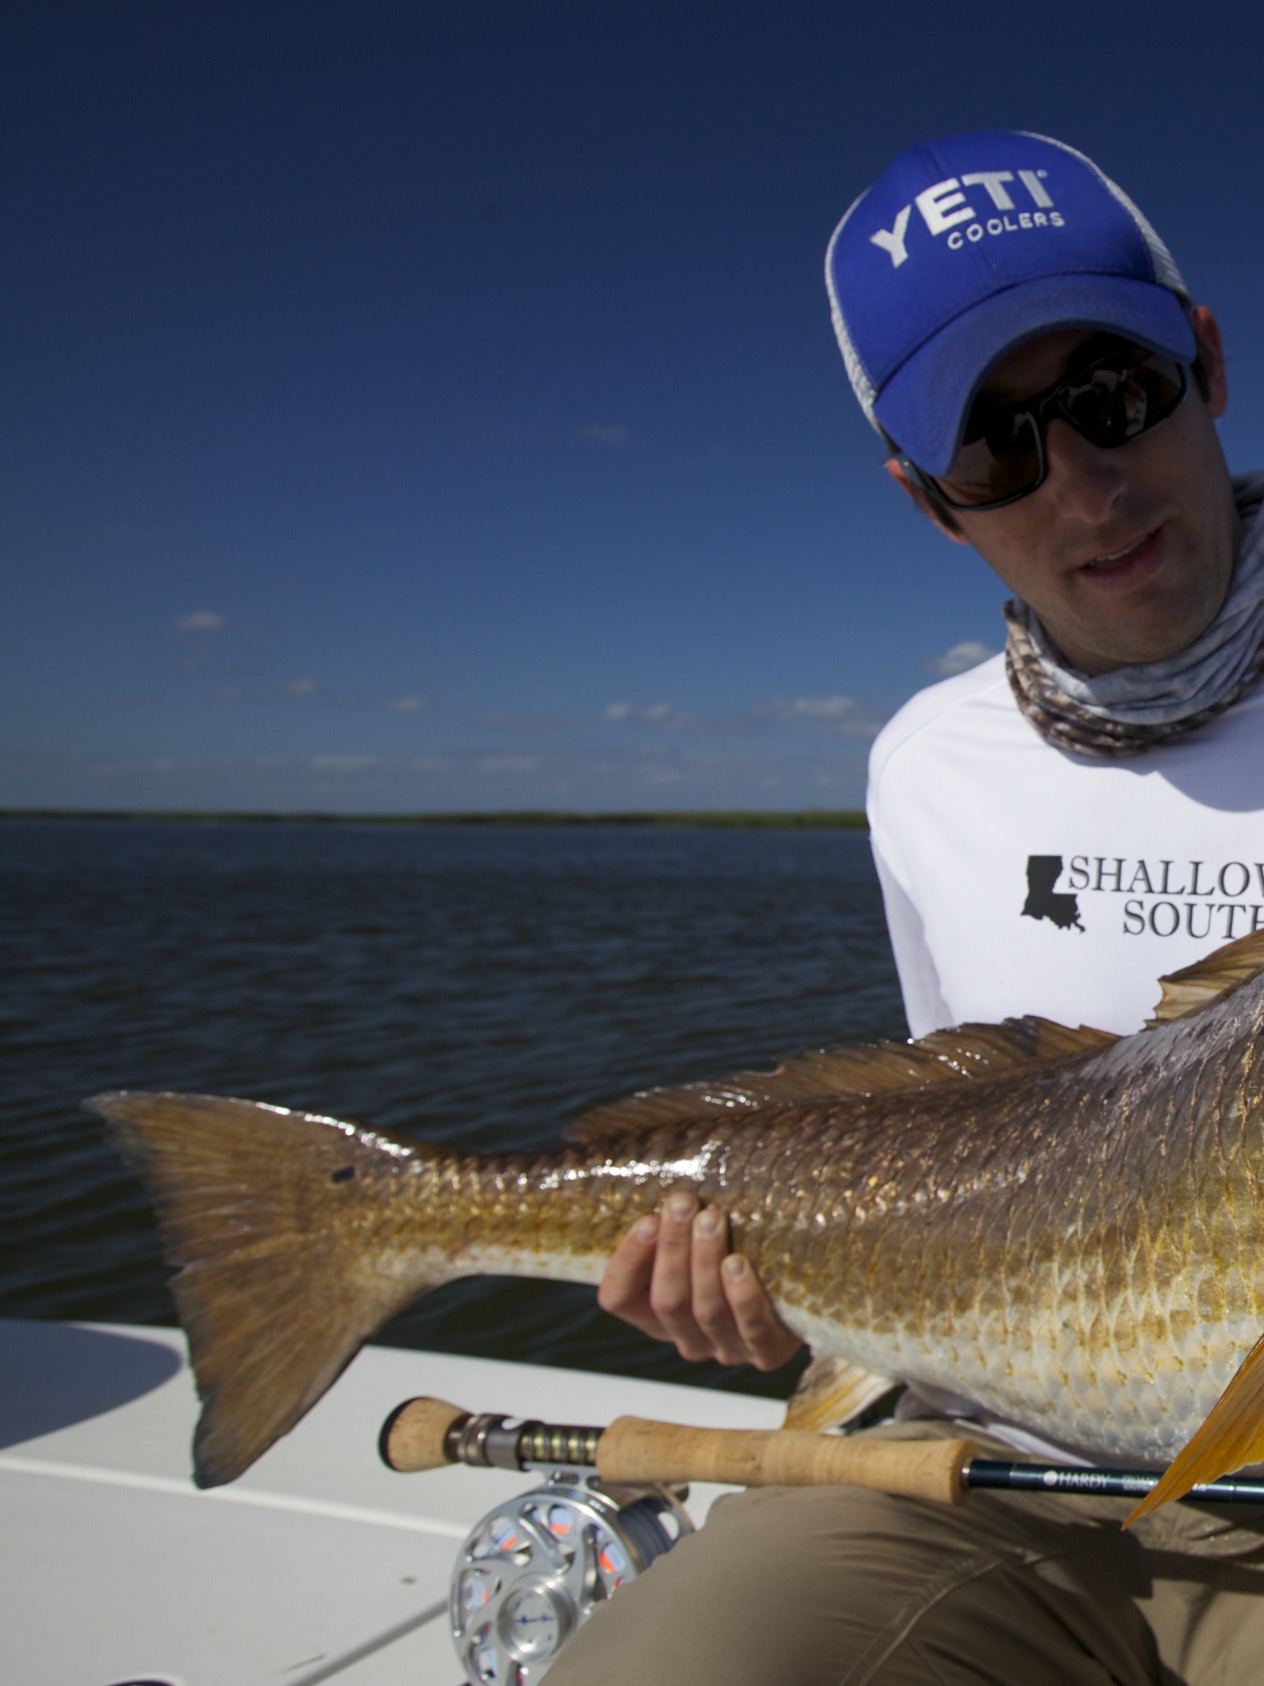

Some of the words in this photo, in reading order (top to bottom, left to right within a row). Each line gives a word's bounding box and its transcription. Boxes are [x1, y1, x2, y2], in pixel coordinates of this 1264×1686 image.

[869, 170, 1054, 269] YETI
[947, 211, 1065, 250] COOLERS
[1059, 1471, 1111, 1489] HARDY
